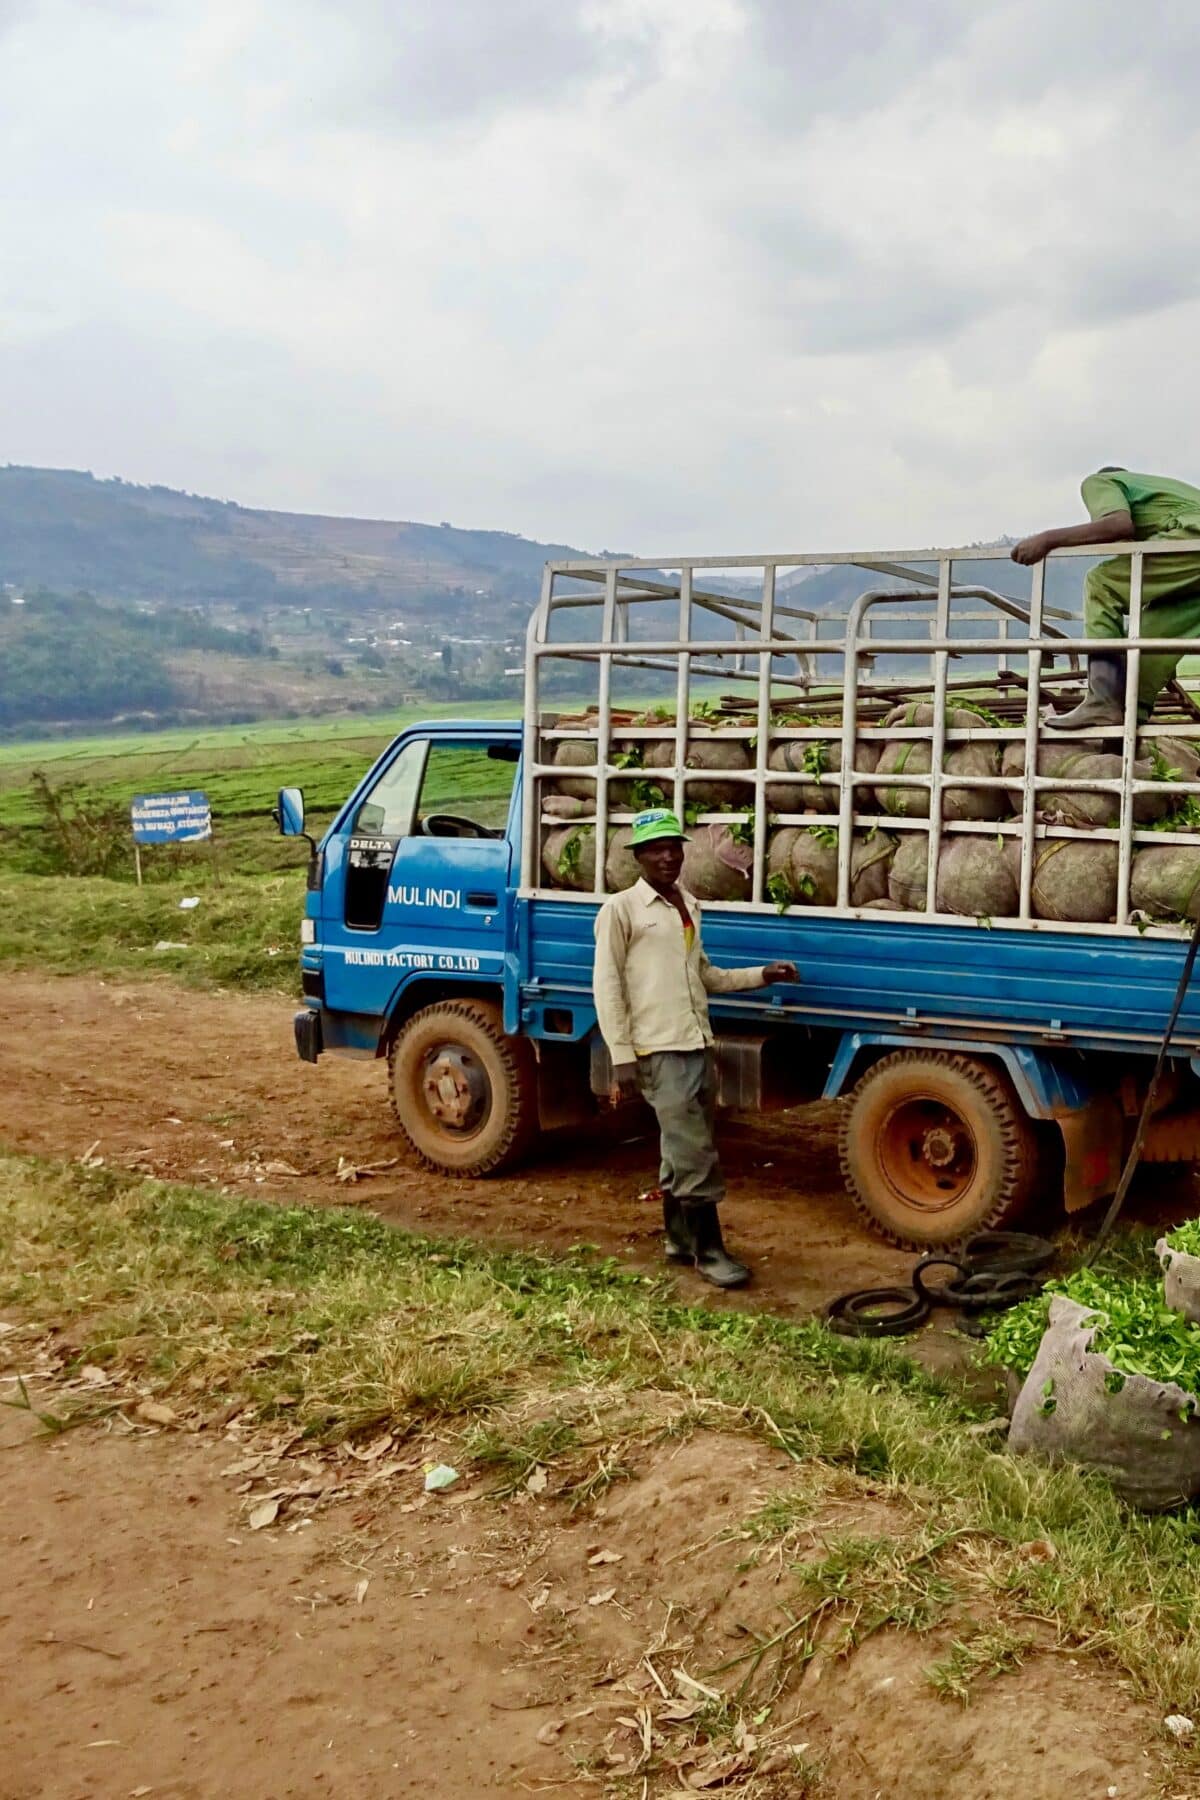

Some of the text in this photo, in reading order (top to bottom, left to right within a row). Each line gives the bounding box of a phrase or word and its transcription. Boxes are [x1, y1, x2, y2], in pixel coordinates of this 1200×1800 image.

[350, 839, 392, 850] DELTA
[387, 884, 461, 909] MULINDI
[386, 952, 434, 969] FACTORY
